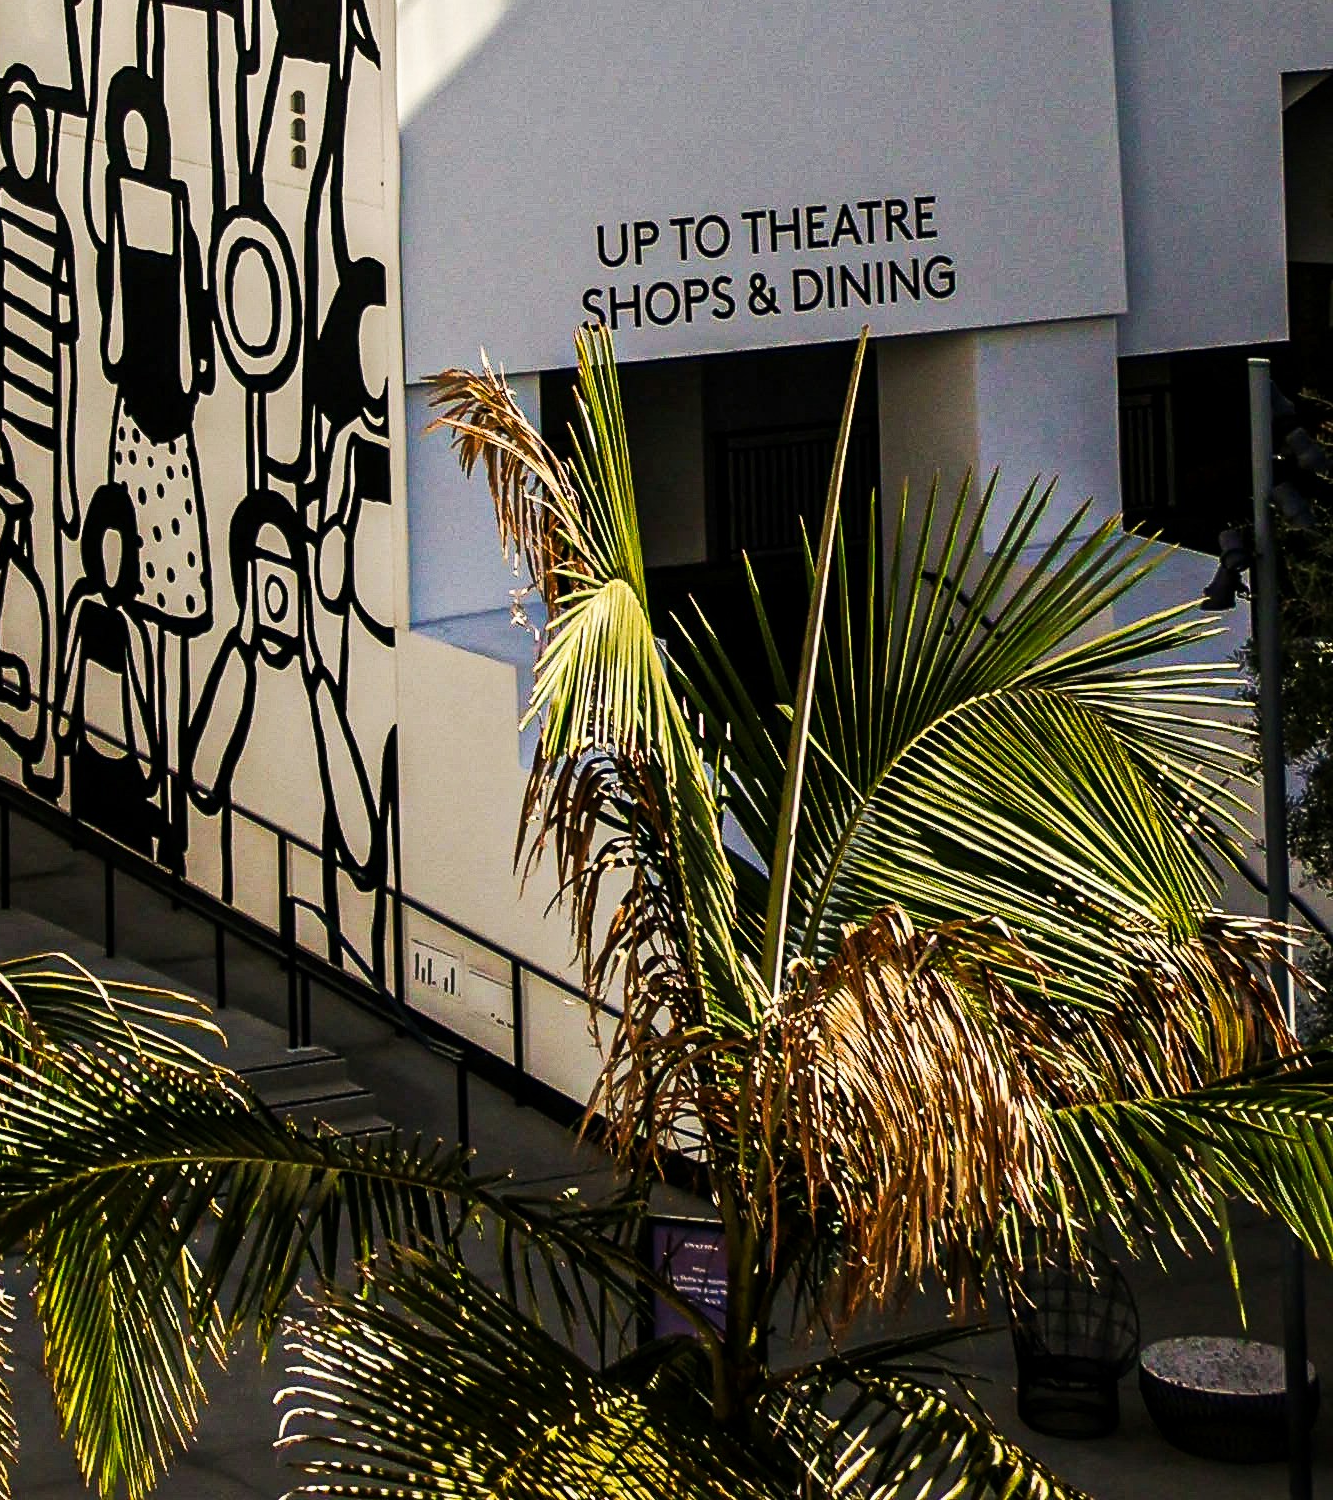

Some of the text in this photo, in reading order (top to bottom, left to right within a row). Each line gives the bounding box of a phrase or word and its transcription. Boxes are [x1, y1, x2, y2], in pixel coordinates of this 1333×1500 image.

[597, 196, 938, 267] UP TO THEATRE
[582, 255, 957, 330] SHOPS & DINING
